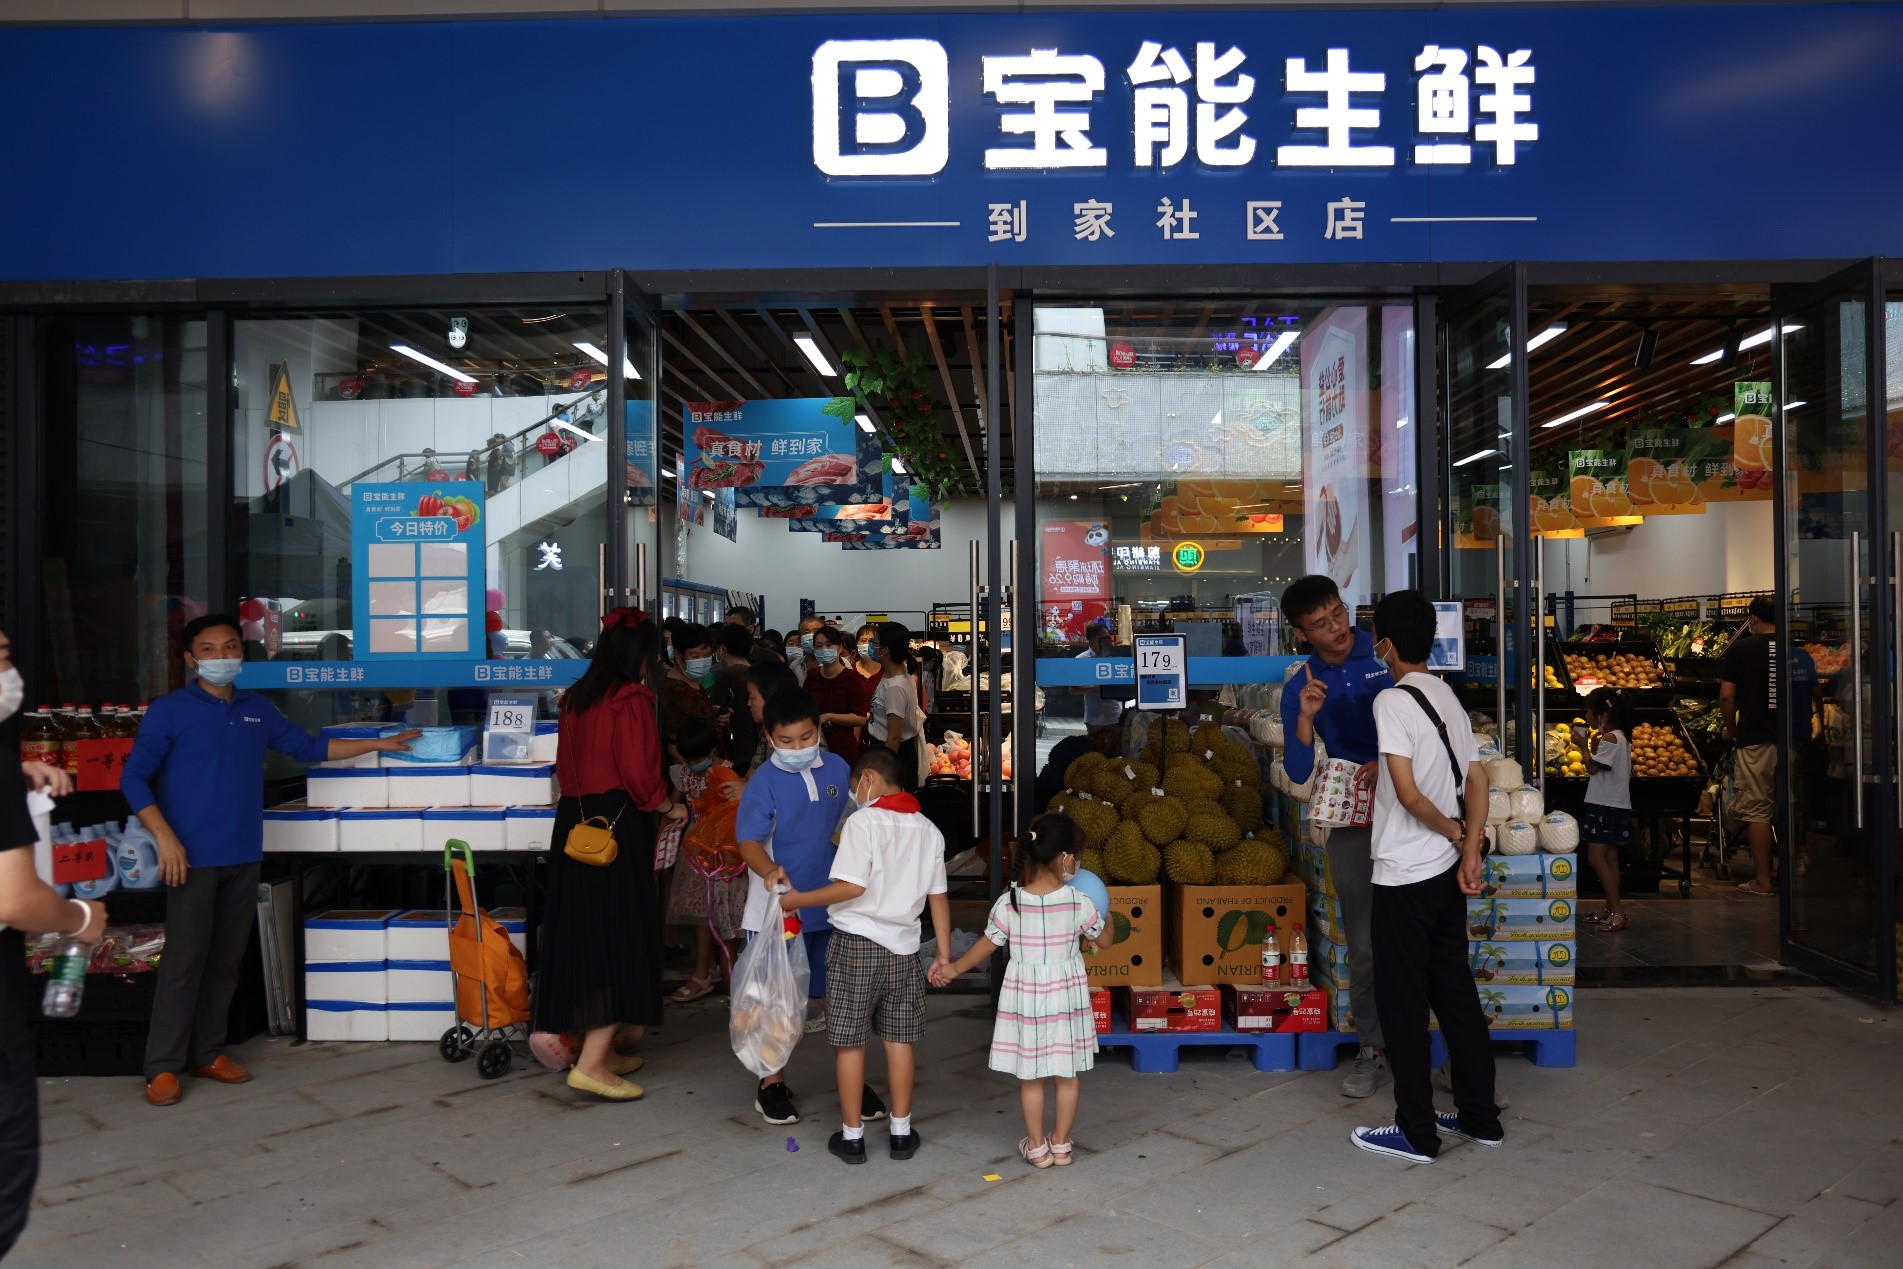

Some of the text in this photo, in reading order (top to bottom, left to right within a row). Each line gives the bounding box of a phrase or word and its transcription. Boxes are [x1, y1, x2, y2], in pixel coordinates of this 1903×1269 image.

[981, 40, 1540, 169] 宝能生鲜
[986, 196, 1367, 243] 到家社区店
[703, 411, 743, 421] 宝能生鲜
[710, 438, 822, 458] 真食材 鲜到家
[1645, 438, 1680, 449] 宝能生鲜
[1585, 458, 1617, 467] 宝能生鲜
[1651, 463, 1697, 479] 真食材
[373, 492, 405, 501] 宝能生鲜
[390, 521, 448, 536] 今日特价
[1142, 652, 1171, 667] 179
[304, 667, 364, 682] 宝能生鲜
[492, 666, 553, 681] 宝能生鲜
[492, 710, 523, 726] 188
[1196, 897, 1239, 905] THAILAND
[1254, 897, 1293, 905] PRODUCT
[1085, 965, 1129, 975] DURIA
[1217, 964, 1262, 976] URIAN
